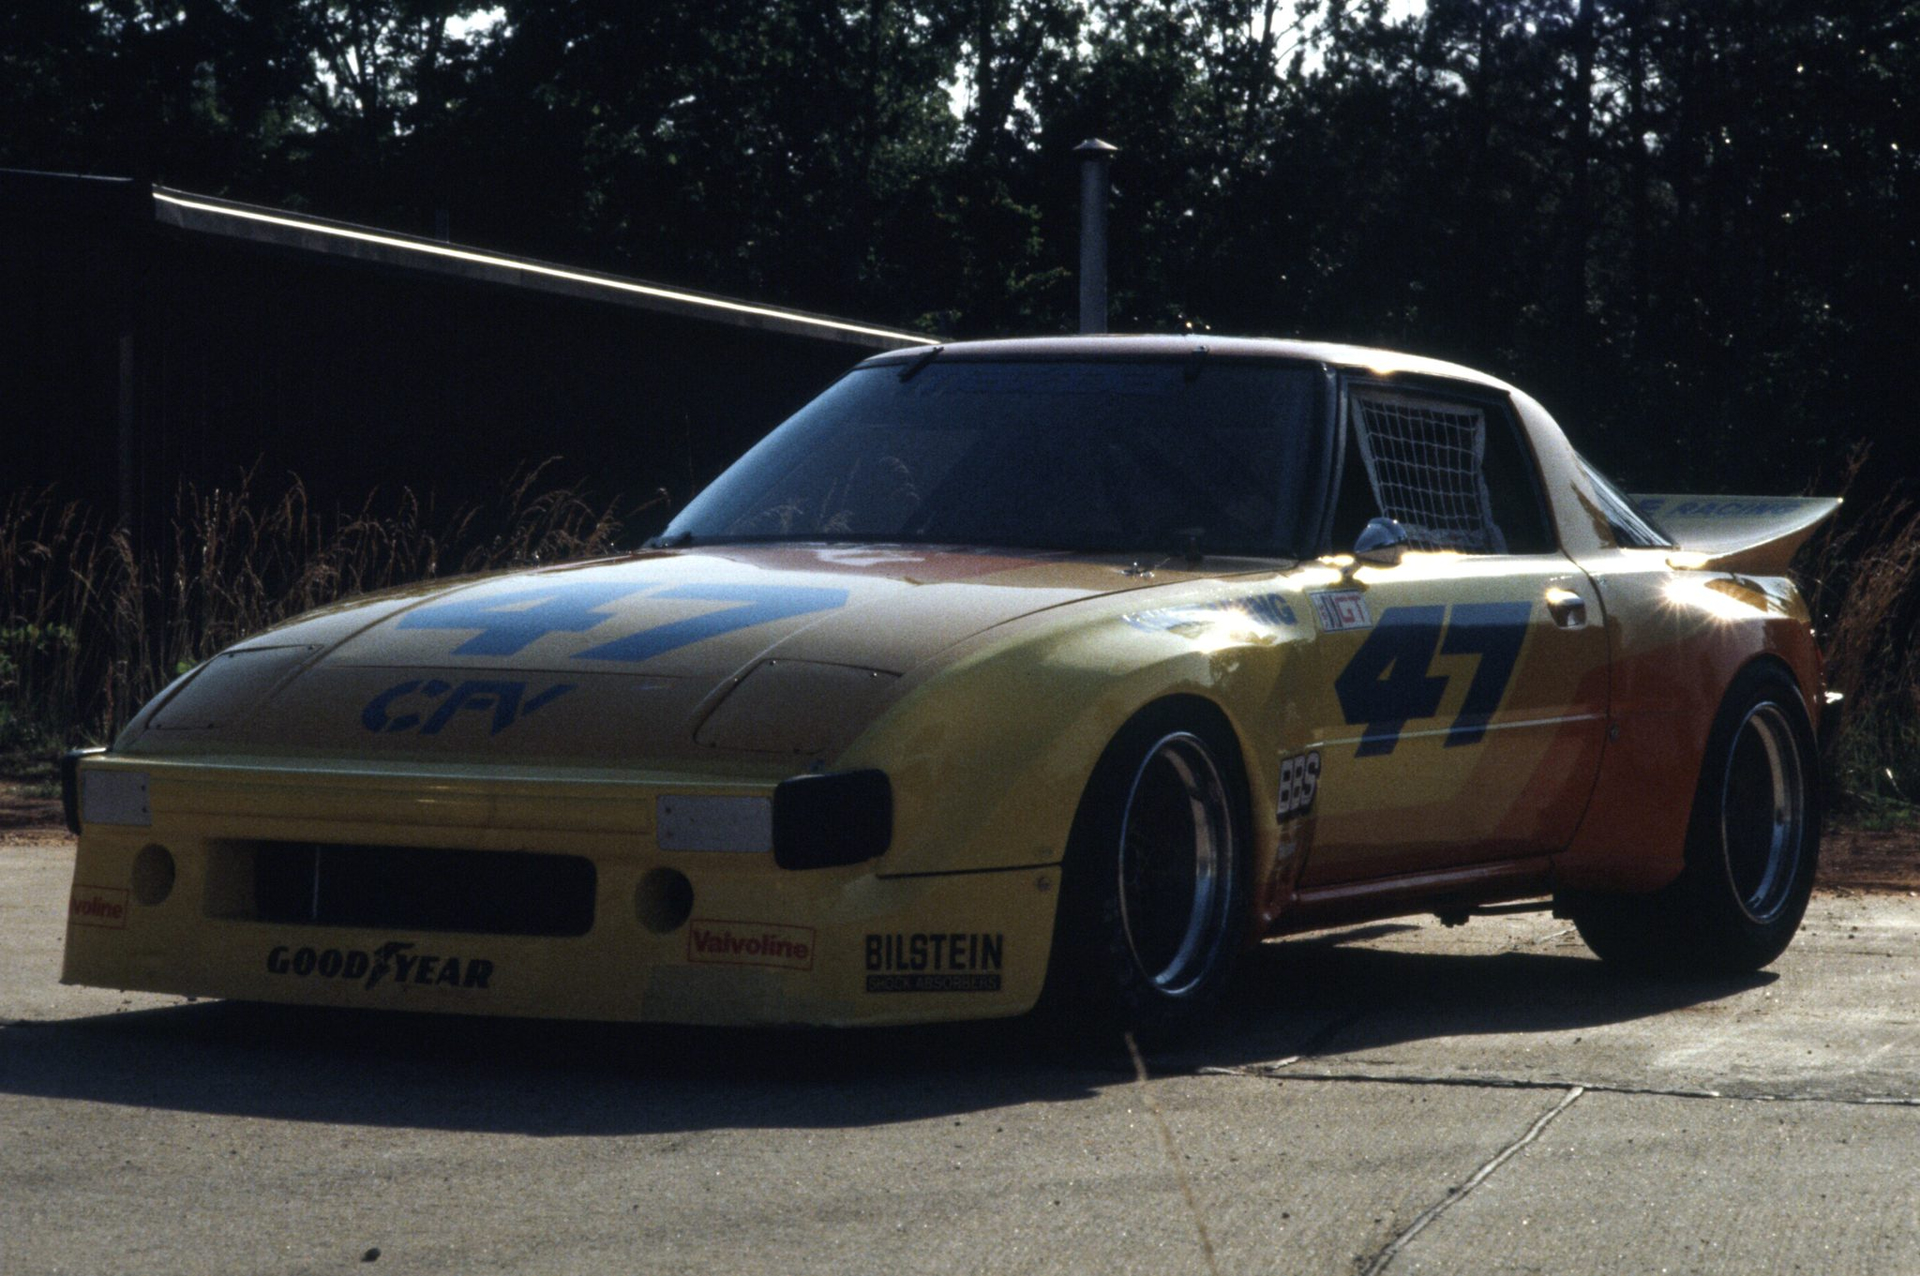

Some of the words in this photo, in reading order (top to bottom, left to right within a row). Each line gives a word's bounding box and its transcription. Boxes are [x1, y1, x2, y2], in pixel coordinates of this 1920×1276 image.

[397, 582, 849, 662] 47
[1334, 601, 1533, 758] 47
[1277, 750, 1321, 824] BBS
[267, 942, 495, 989] GOODYEAR
[692, 930, 809, 959] Valvoline
[866, 934, 1003, 970] BILSTEIN
[868, 975, 912, 991] SHOCK
[915, 975, 998, 991] ABSORBERS
